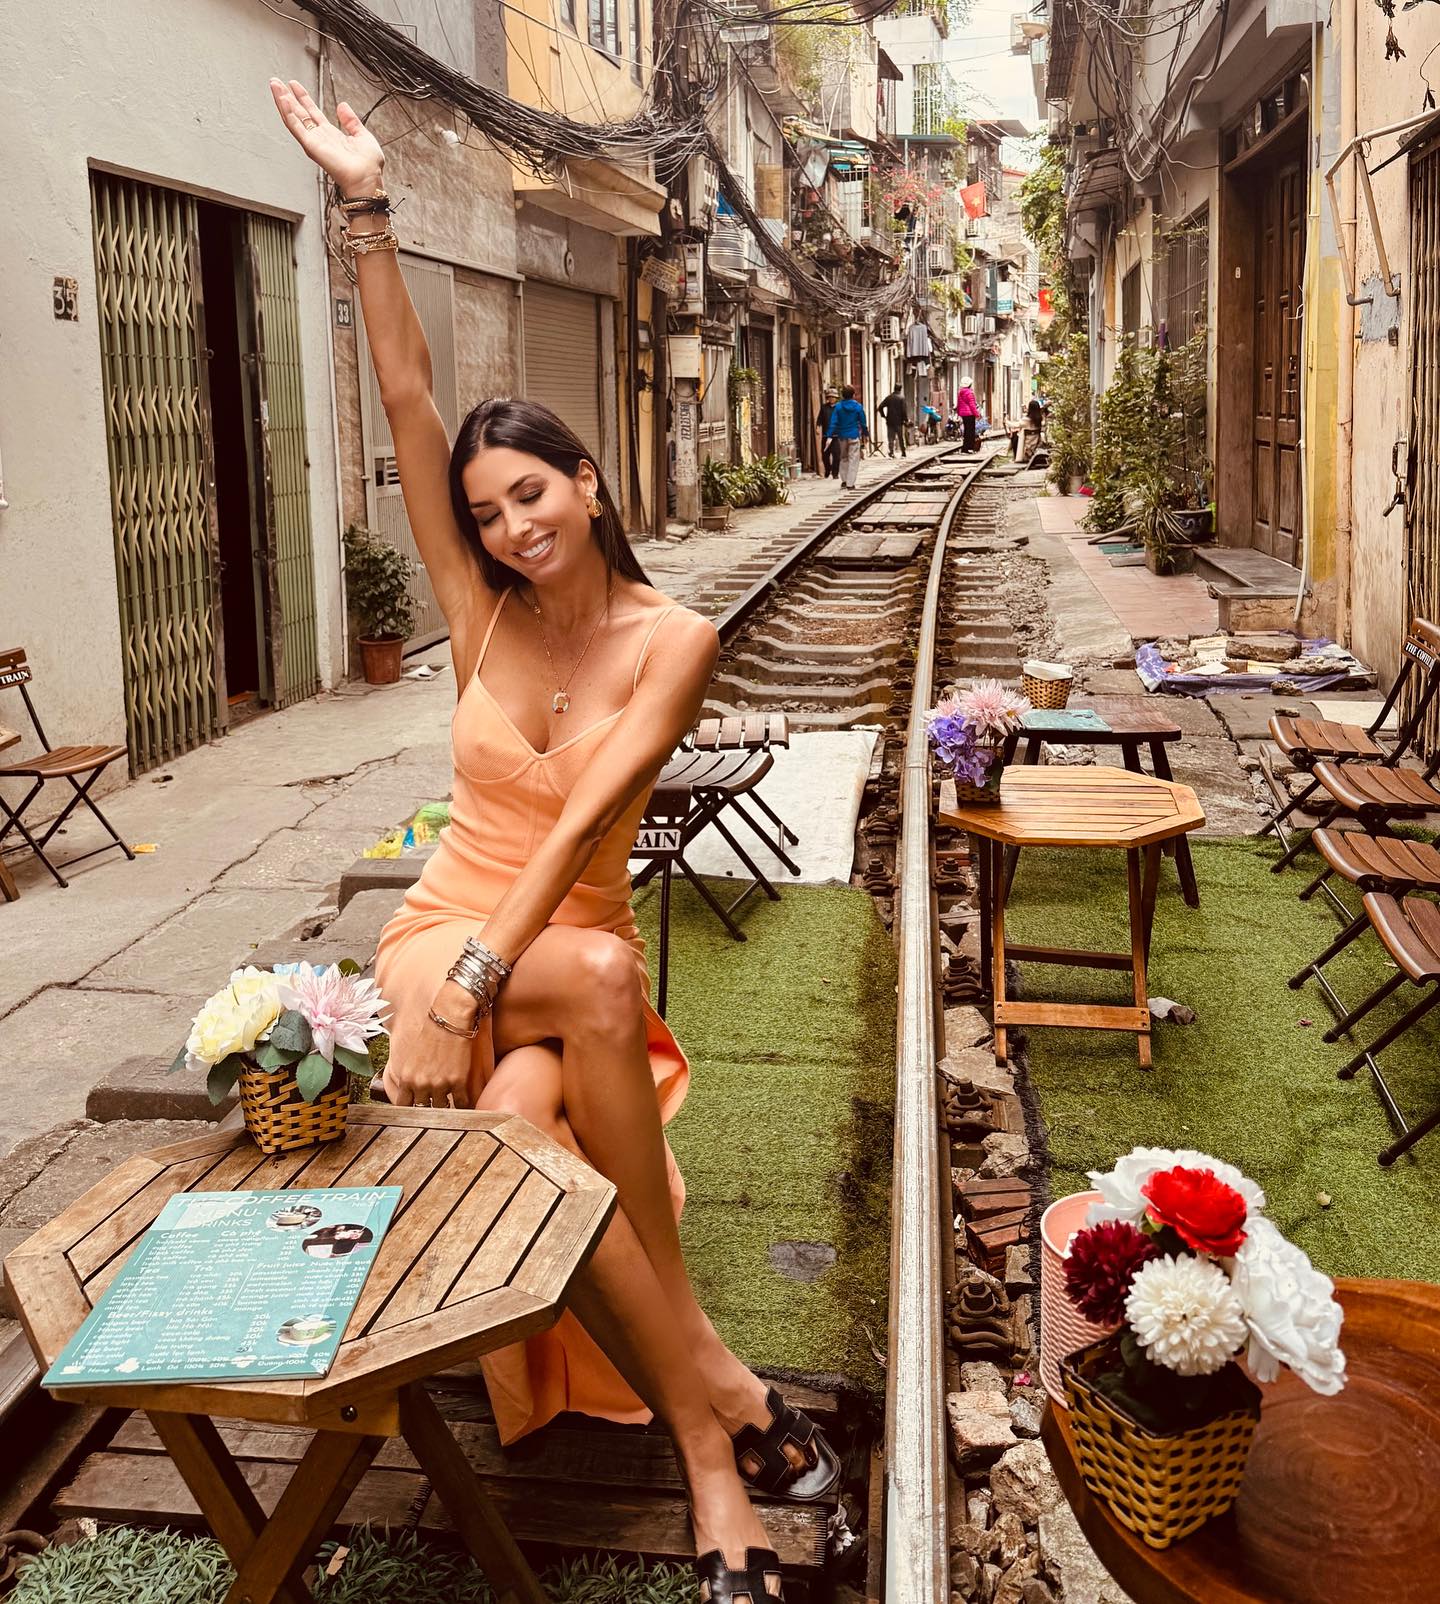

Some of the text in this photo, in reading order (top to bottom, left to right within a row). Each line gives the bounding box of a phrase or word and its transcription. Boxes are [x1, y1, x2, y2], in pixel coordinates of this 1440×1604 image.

[338, 303, 350, 323] 33
[1405, 641, 1418, 656] THE
[0, 671, 29, 684] TRAIN
[634, 831, 678, 848] AIN
[222, 1193, 315, 1205] COFFEE
[320, 1191, 387, 1201] TRAIN
[160, 1231, 199, 1240] Coffee
[140, 1266, 161, 1275] Tea
[175, 1307, 214, 1317] drinks
